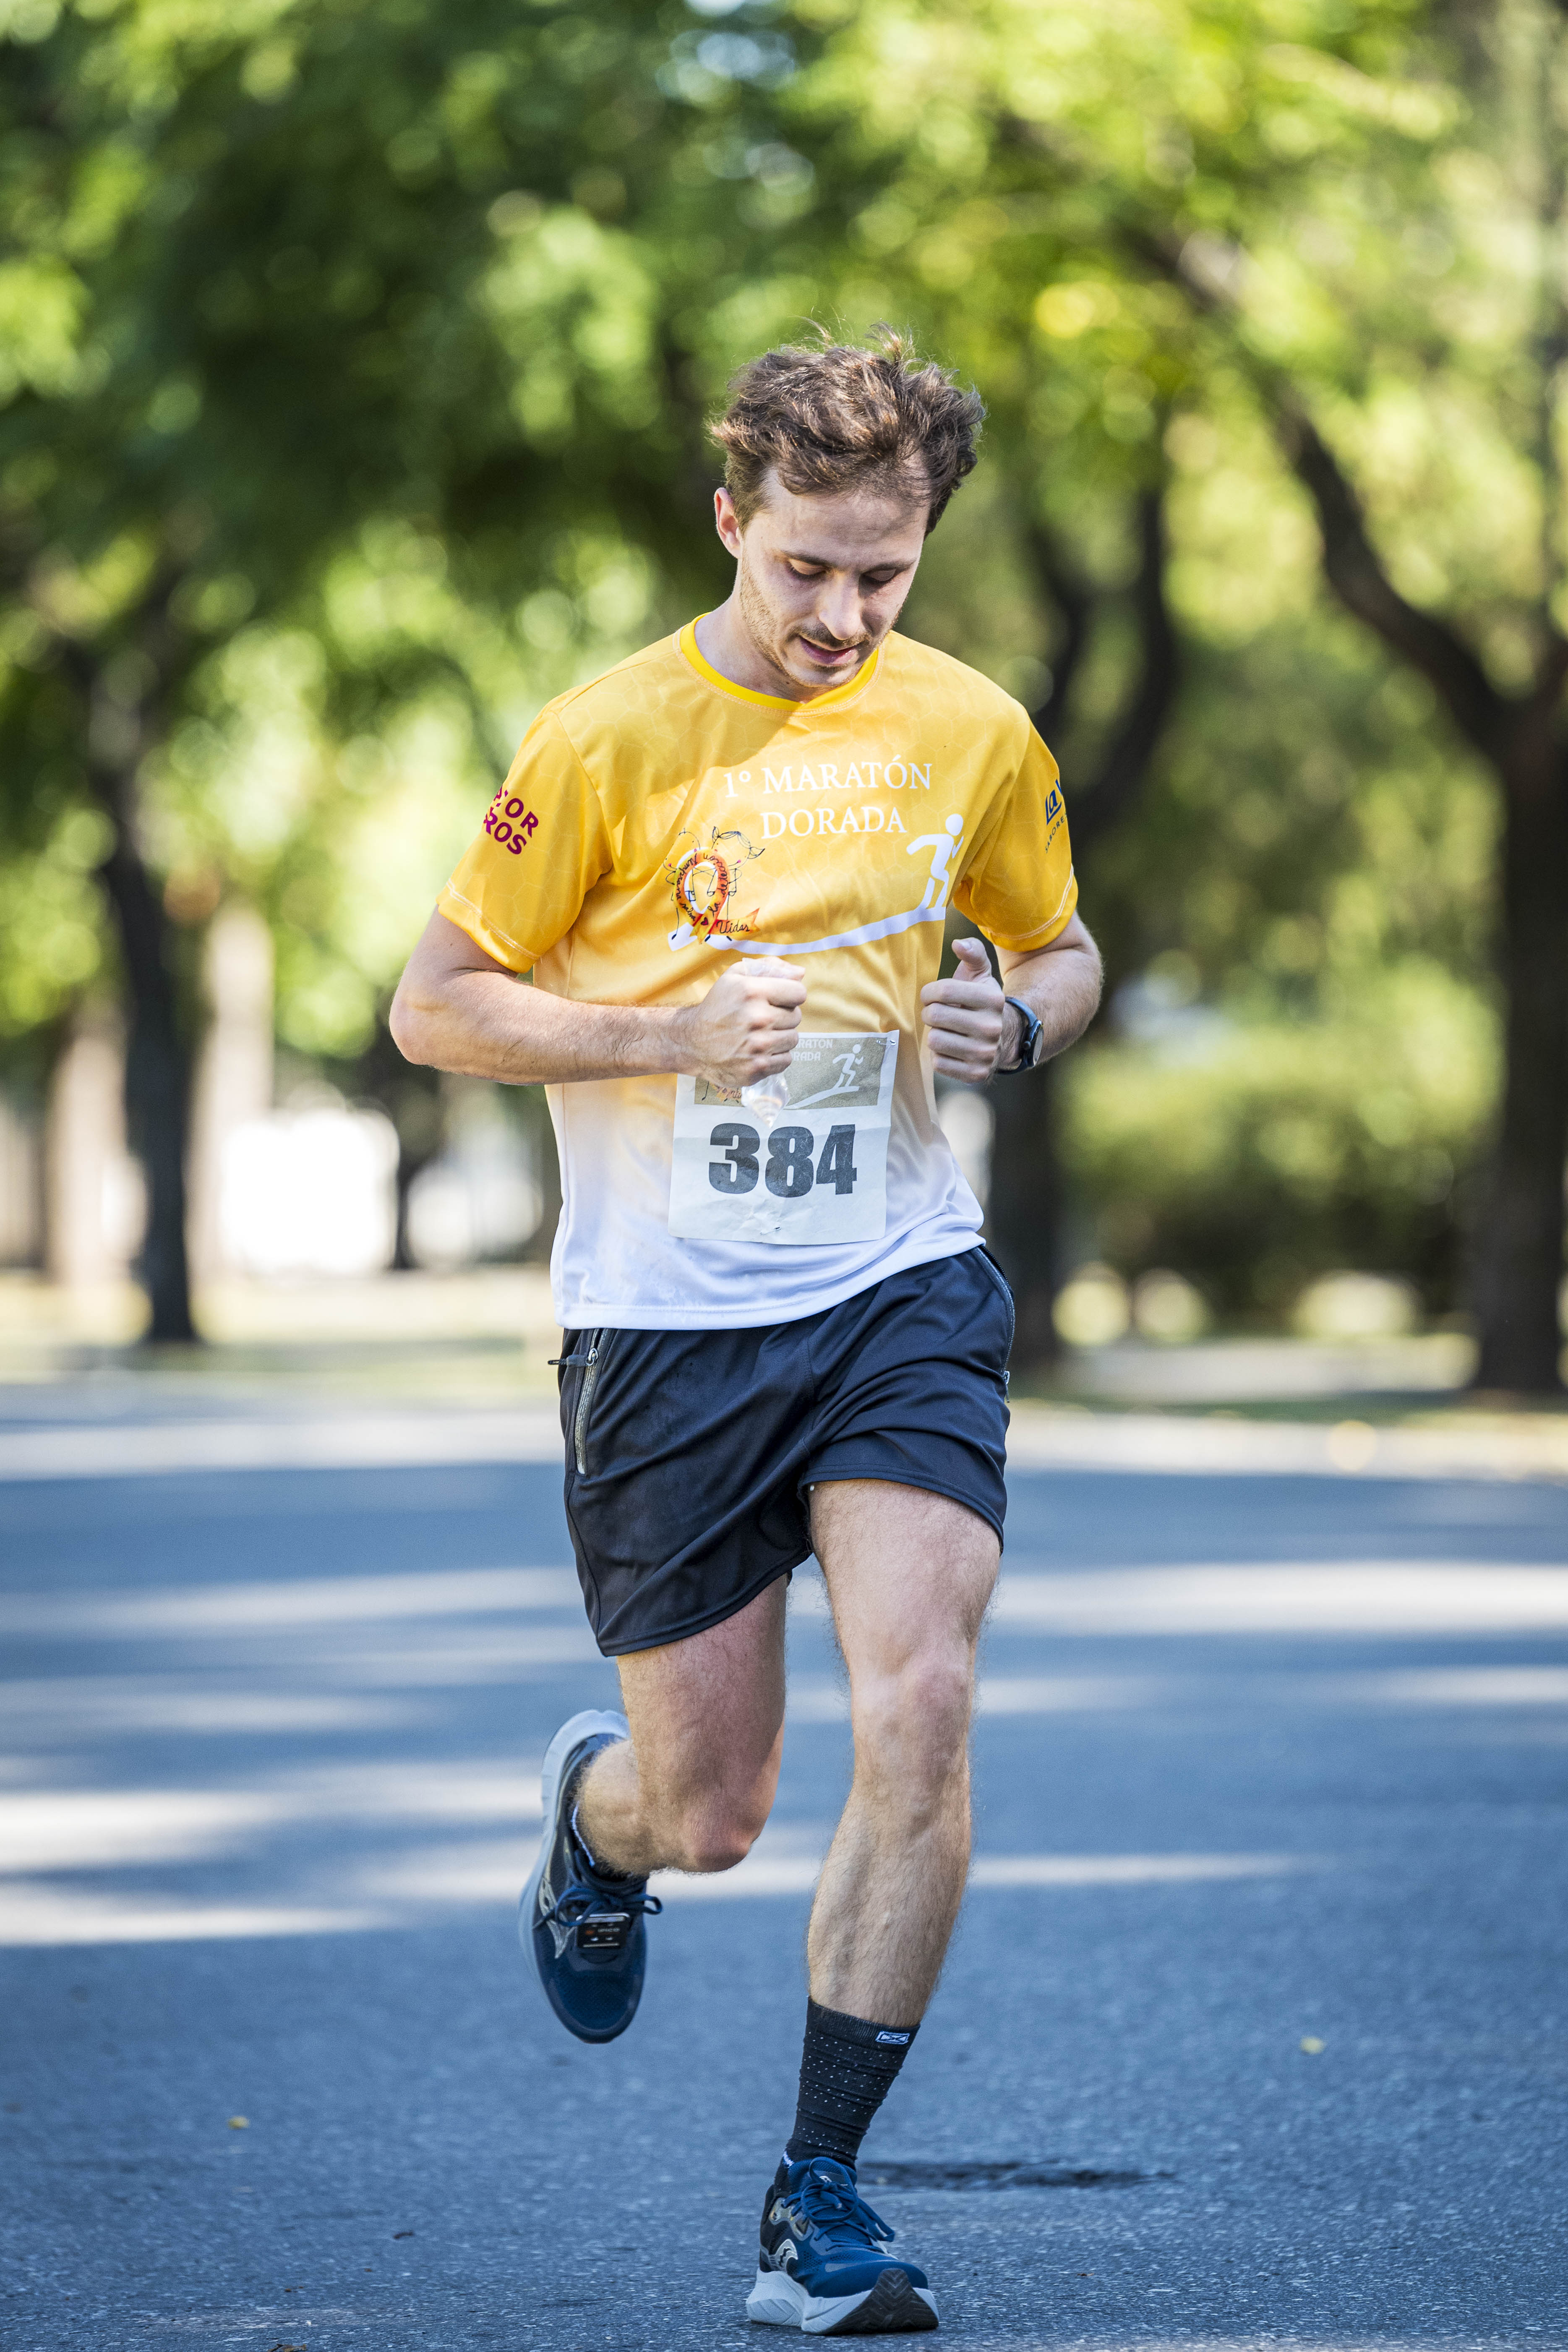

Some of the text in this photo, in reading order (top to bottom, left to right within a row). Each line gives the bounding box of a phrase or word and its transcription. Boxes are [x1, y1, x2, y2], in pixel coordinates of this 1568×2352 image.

[761, 754, 932, 794] MARATÓN
[760, 807, 907, 839] DORADA
[1045, 789, 1062, 826] La
[1045, 813, 1067, 854] SABORE
[679, 902, 697, 922] salva
[790, 1051, 821, 1061] RADA
[796, 1039, 833, 1048] RATON
[708, 1123, 857, 1198] 384
